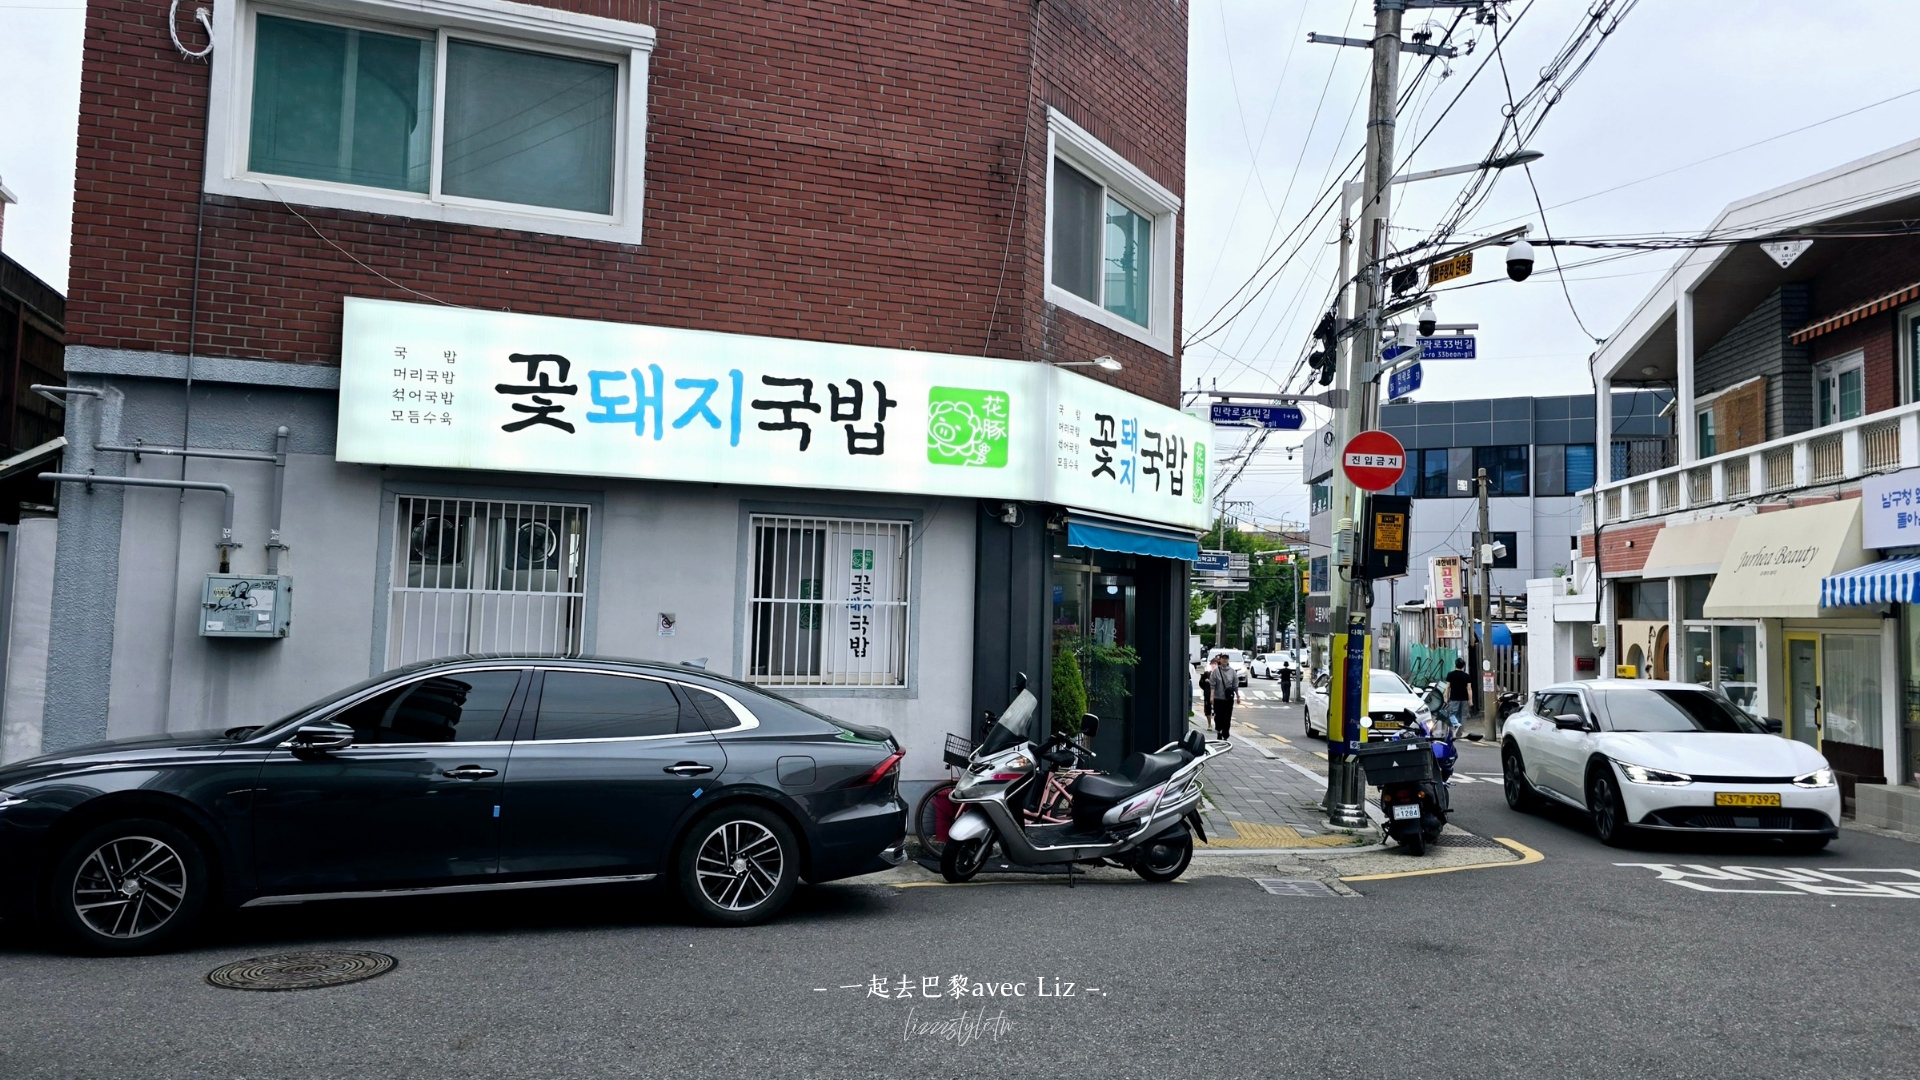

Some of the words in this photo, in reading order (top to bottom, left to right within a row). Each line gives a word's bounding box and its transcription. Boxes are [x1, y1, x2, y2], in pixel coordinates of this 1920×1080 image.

[393, 367, 456, 385] 머리국밥
[392, 388, 455, 405] 섞어국밥
[495, 352, 898, 456] 꽃돼지국밥
[390, 410, 453, 426] 모듬수육
[981, 394, 1007, 440] 花豚
[1352, 455, 1398, 467] 진입금지
[1881, 488, 1912, 509] 남구청
[1897, 511, 1920, 530] 돌아
[1773, 545, 1820, 569] Beauty
[1749, 794, 1776, 806] 7392
